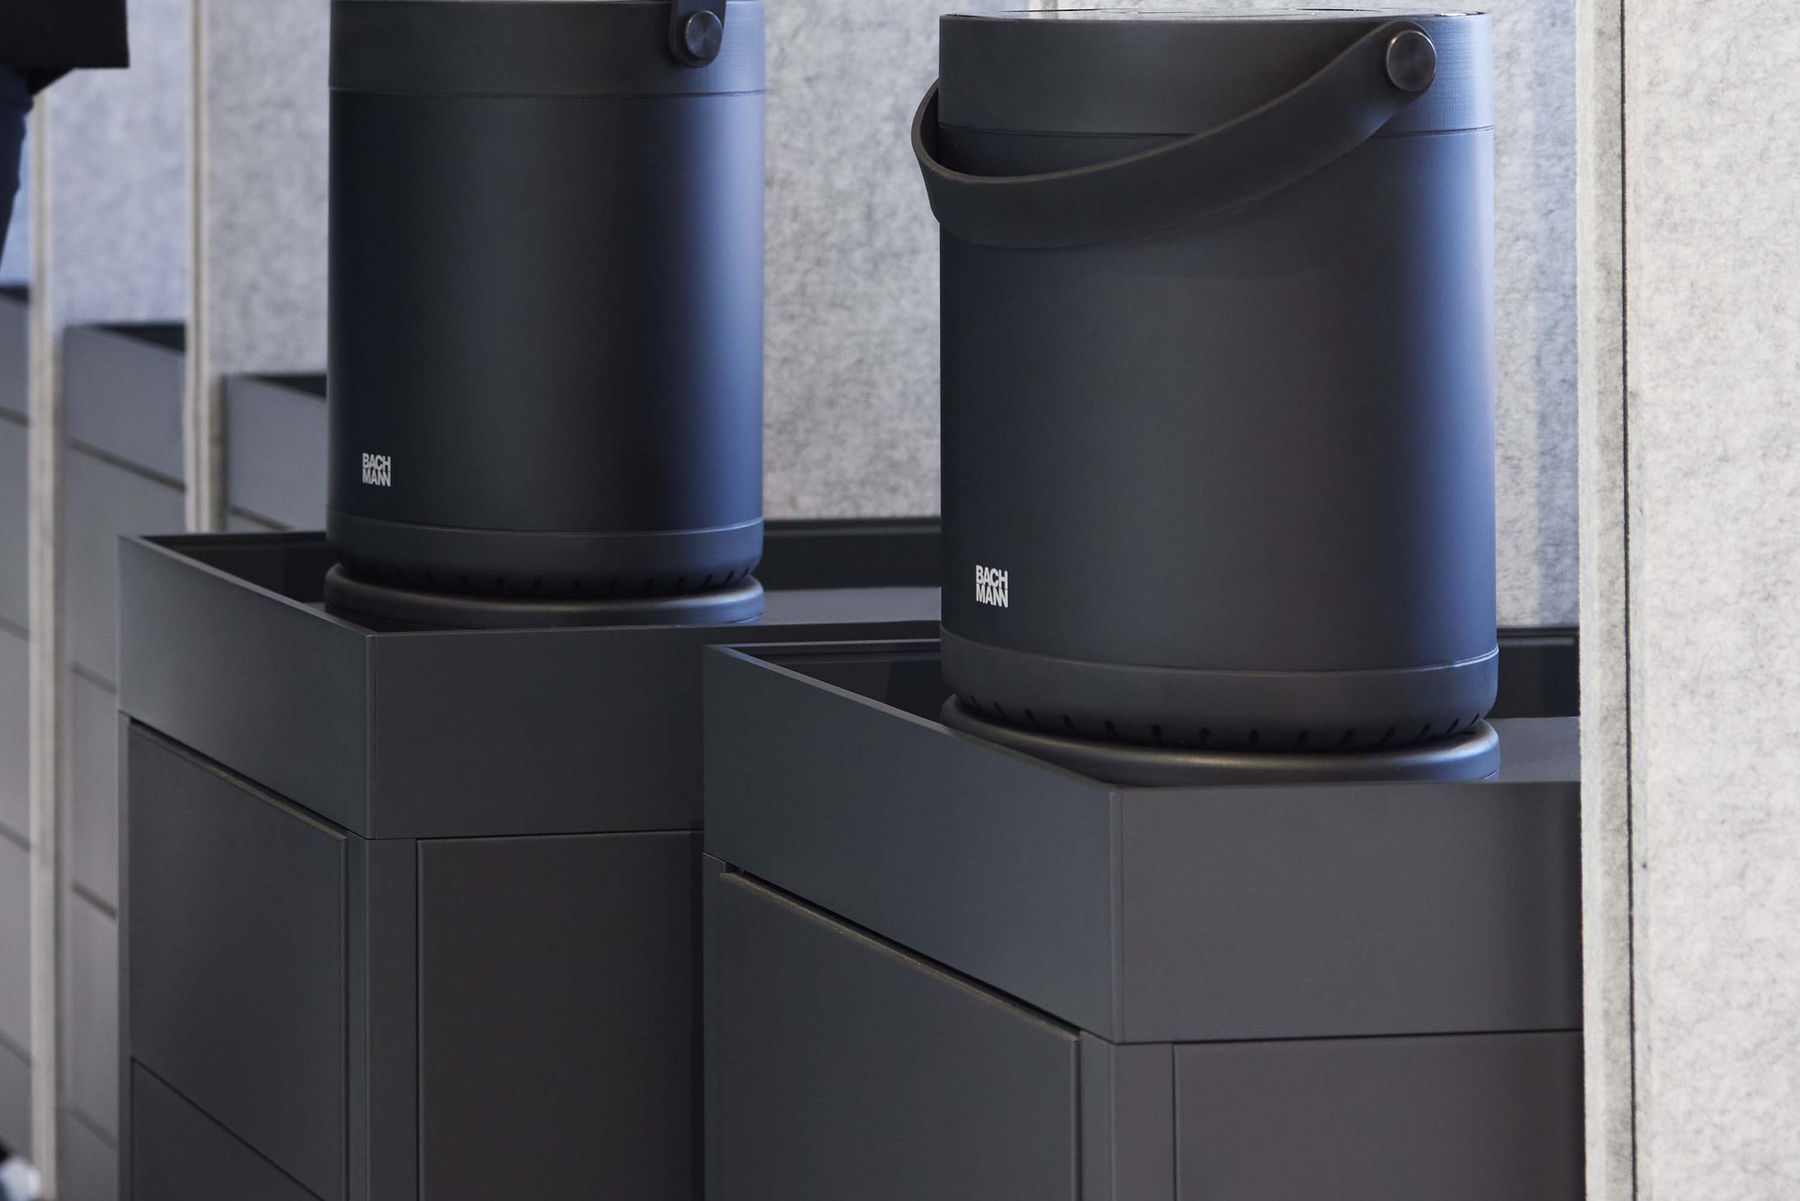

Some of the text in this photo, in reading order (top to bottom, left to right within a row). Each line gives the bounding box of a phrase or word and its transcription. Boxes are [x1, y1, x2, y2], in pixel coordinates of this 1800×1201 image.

[362, 452, 391, 471] BACH
[362, 469, 391, 487] MANN
[976, 564, 1009, 589] BACH
[976, 583, 1009, 608] MANN
